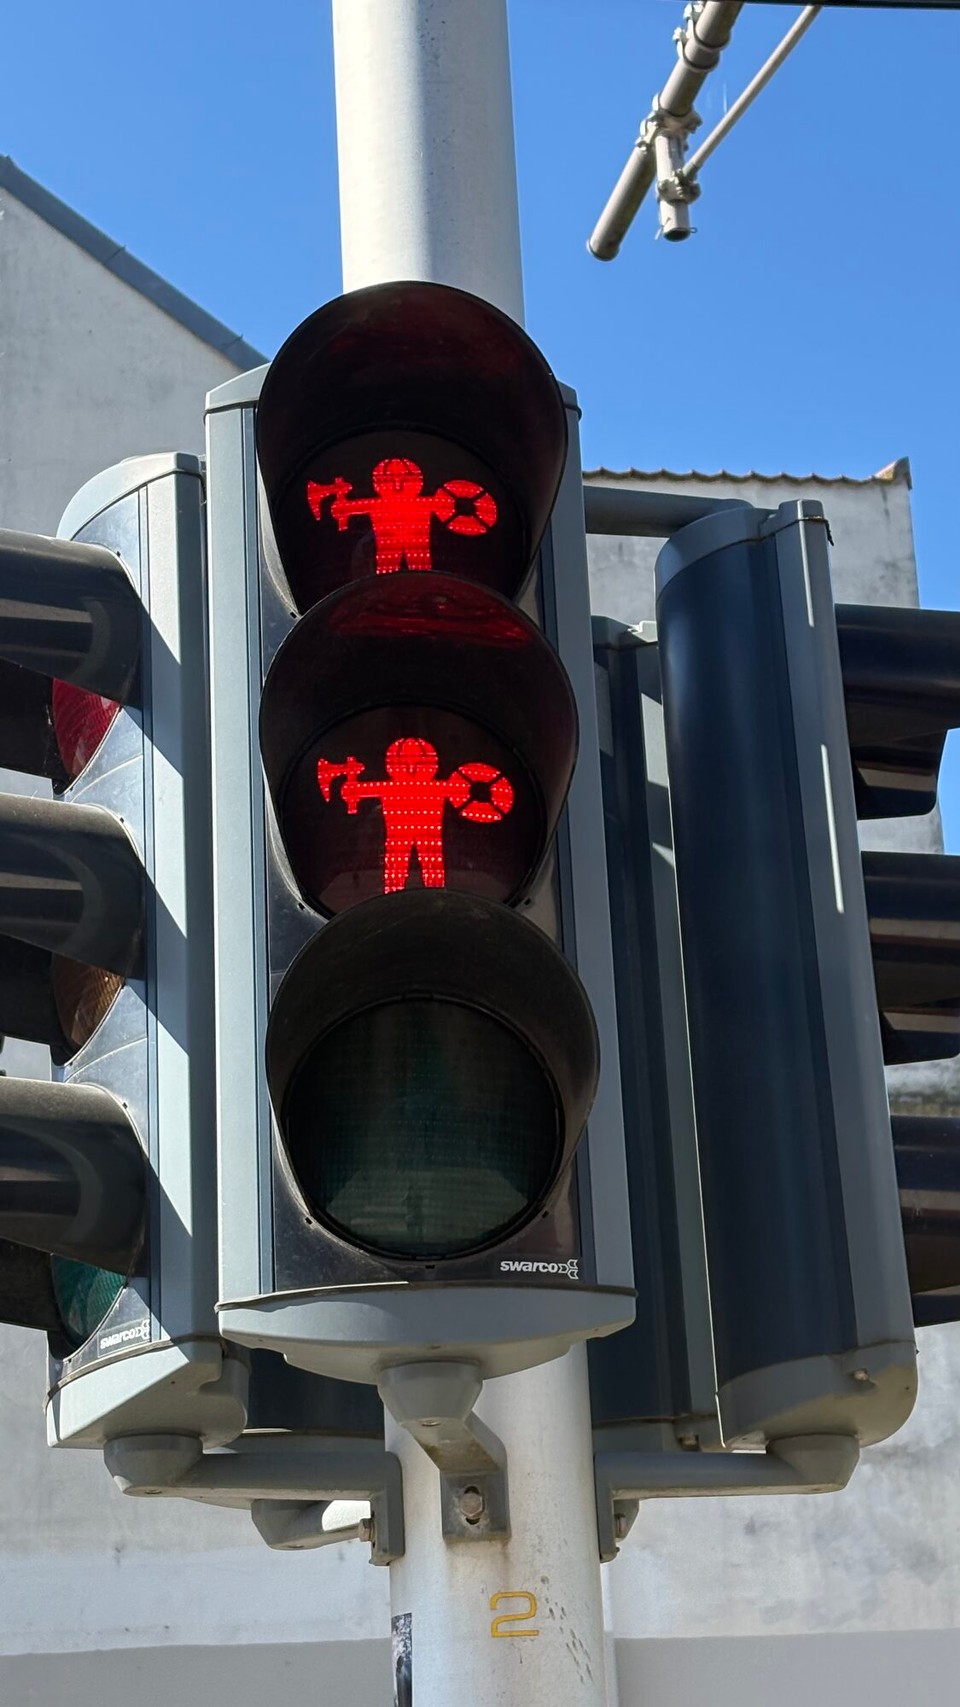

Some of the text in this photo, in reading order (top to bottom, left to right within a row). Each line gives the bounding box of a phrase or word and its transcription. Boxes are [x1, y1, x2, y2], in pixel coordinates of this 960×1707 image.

[500, 1261, 558, 1273] swarco
[100, 1328, 135, 1349] swarco
[490, 1591, 540, 1638] 2
